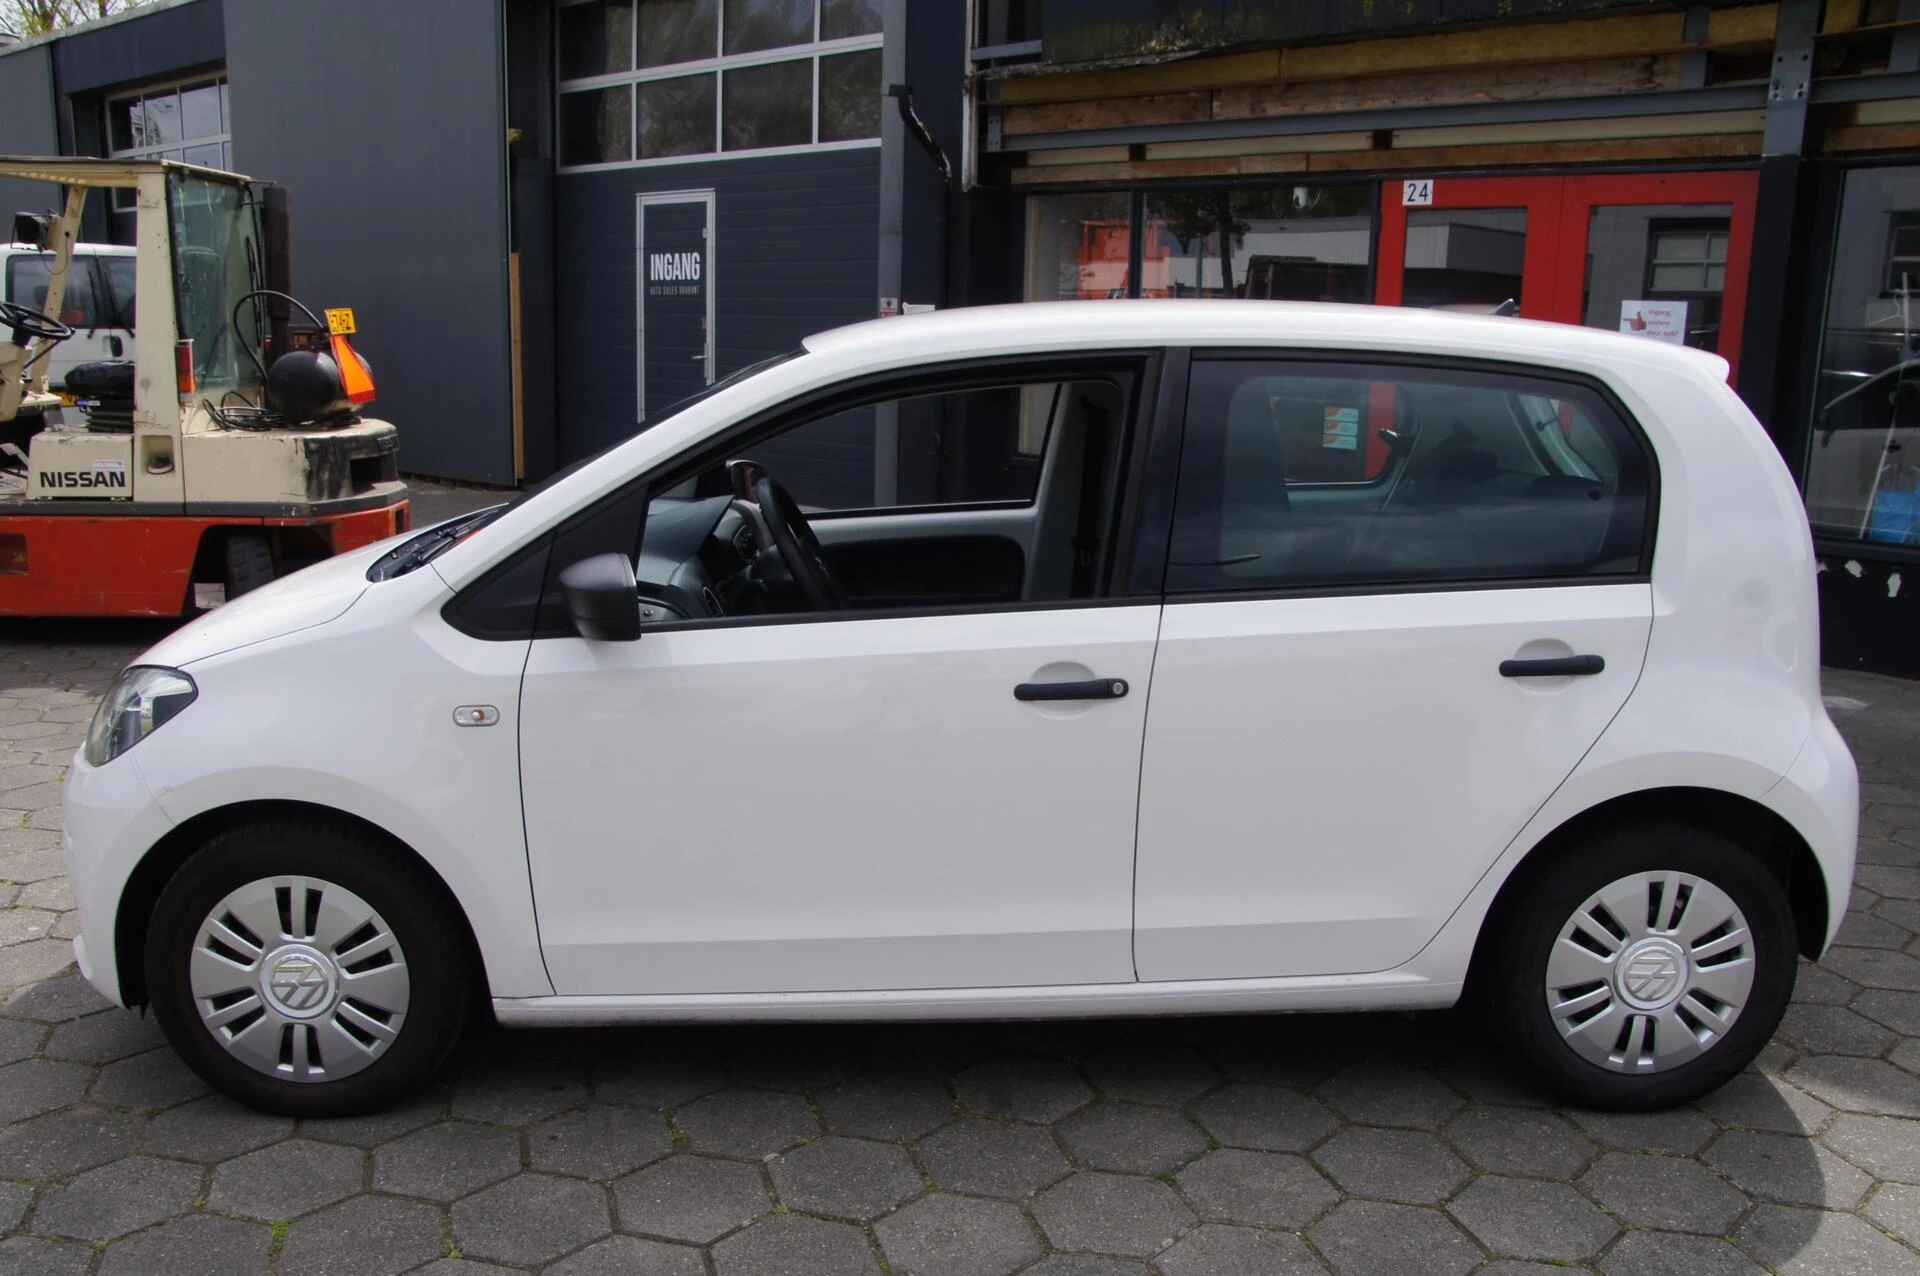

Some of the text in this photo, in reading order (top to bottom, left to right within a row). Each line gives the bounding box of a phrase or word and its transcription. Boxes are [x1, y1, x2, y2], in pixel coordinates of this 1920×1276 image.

[1407, 182, 1429, 202] 24
[650, 252, 700, 281] INGANG
[663, 285, 677, 296] SALES
[40, 471, 126, 488] NISSAN
